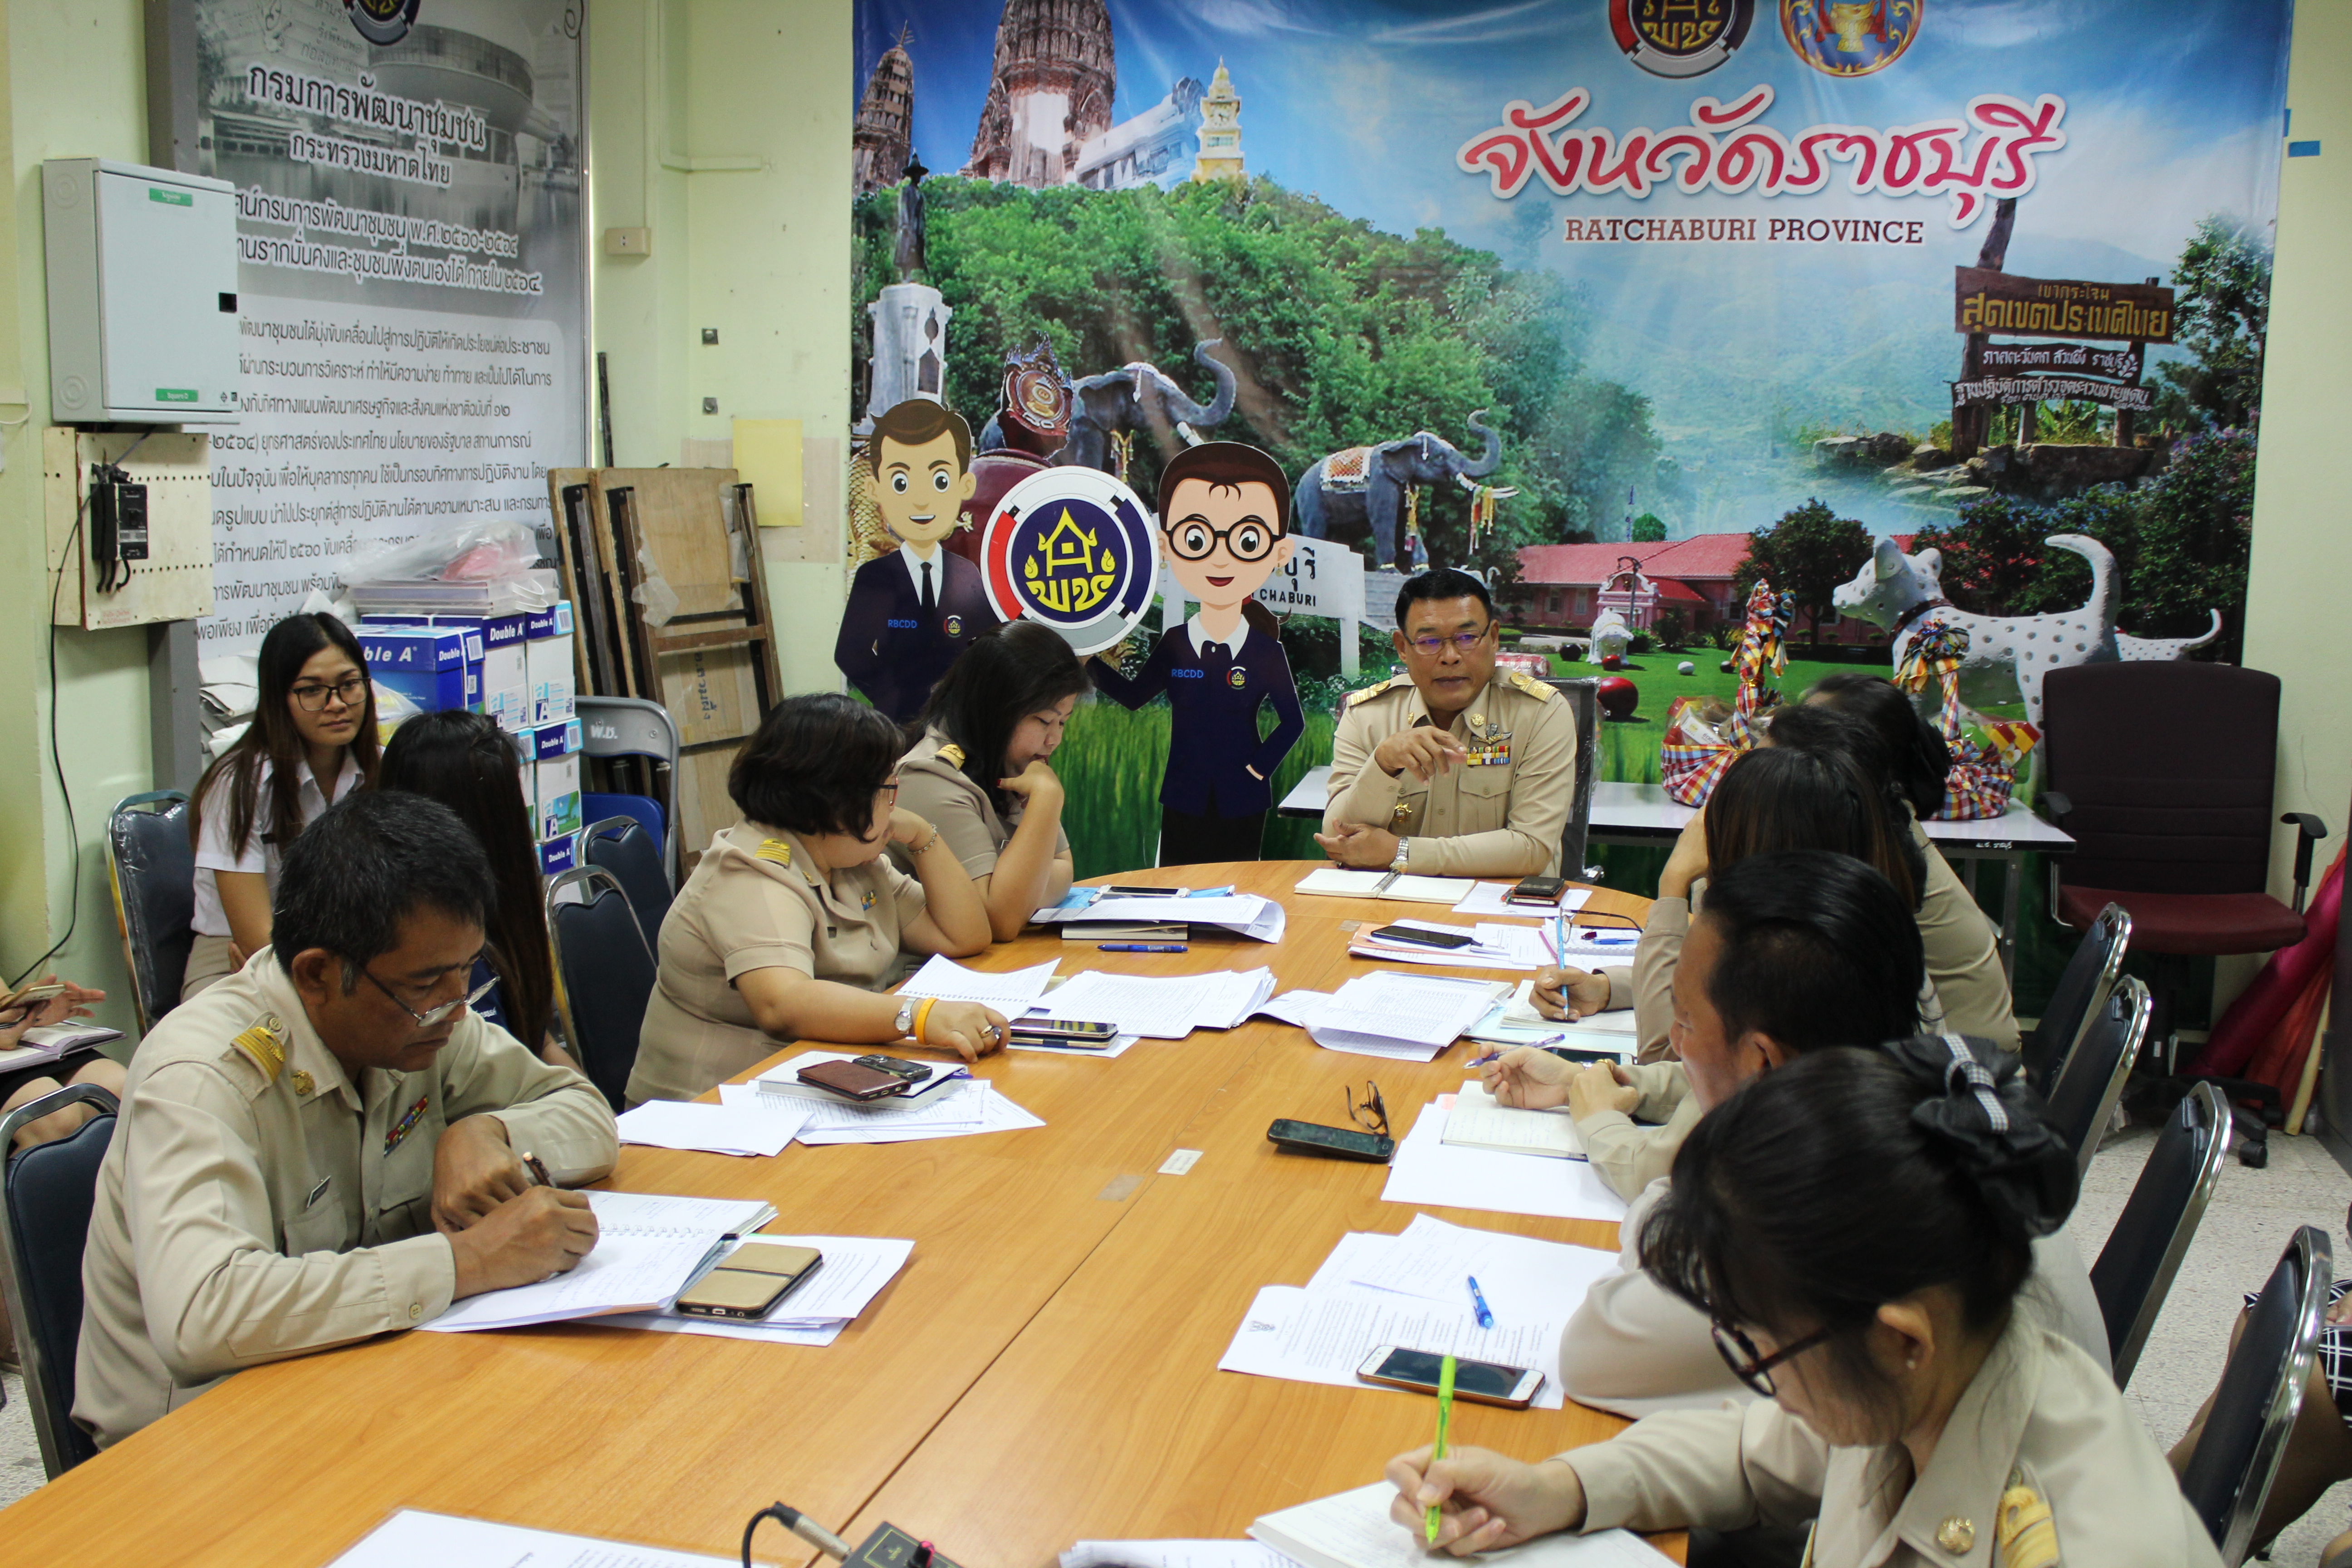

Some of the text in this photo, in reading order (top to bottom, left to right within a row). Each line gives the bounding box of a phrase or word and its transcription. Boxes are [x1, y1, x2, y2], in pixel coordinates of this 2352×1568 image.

[250, 66, 484, 154] กรมการพัฒนาชุมชน
[292, 134, 451, 184] กระทรวงมหาดไทย
[1464, 92, 2058, 220] จังหวัดราชบุรี
[1565, 218, 1924, 245] RATCHABURI PROVINCE
[2038, 283, 2110, 301] เขากระโจม
[1962, 292, 2169, 337] สุดเขตประเทศไทย
[1272, 546, 1315, 592] บุรี
[1252, 588, 1316, 607] CHABURI
[490, 622, 523, 642] Double A
[531, 618, 553, 630] Double A
[888, 619, 917, 628] RBCDD
[398, 647, 412, 662] A
[439, 647, 461, 662] Double
[1171, 669, 1204, 678] RBCDD
[541, 735, 564, 749] Double A
[548, 848, 570, 863] Double A
